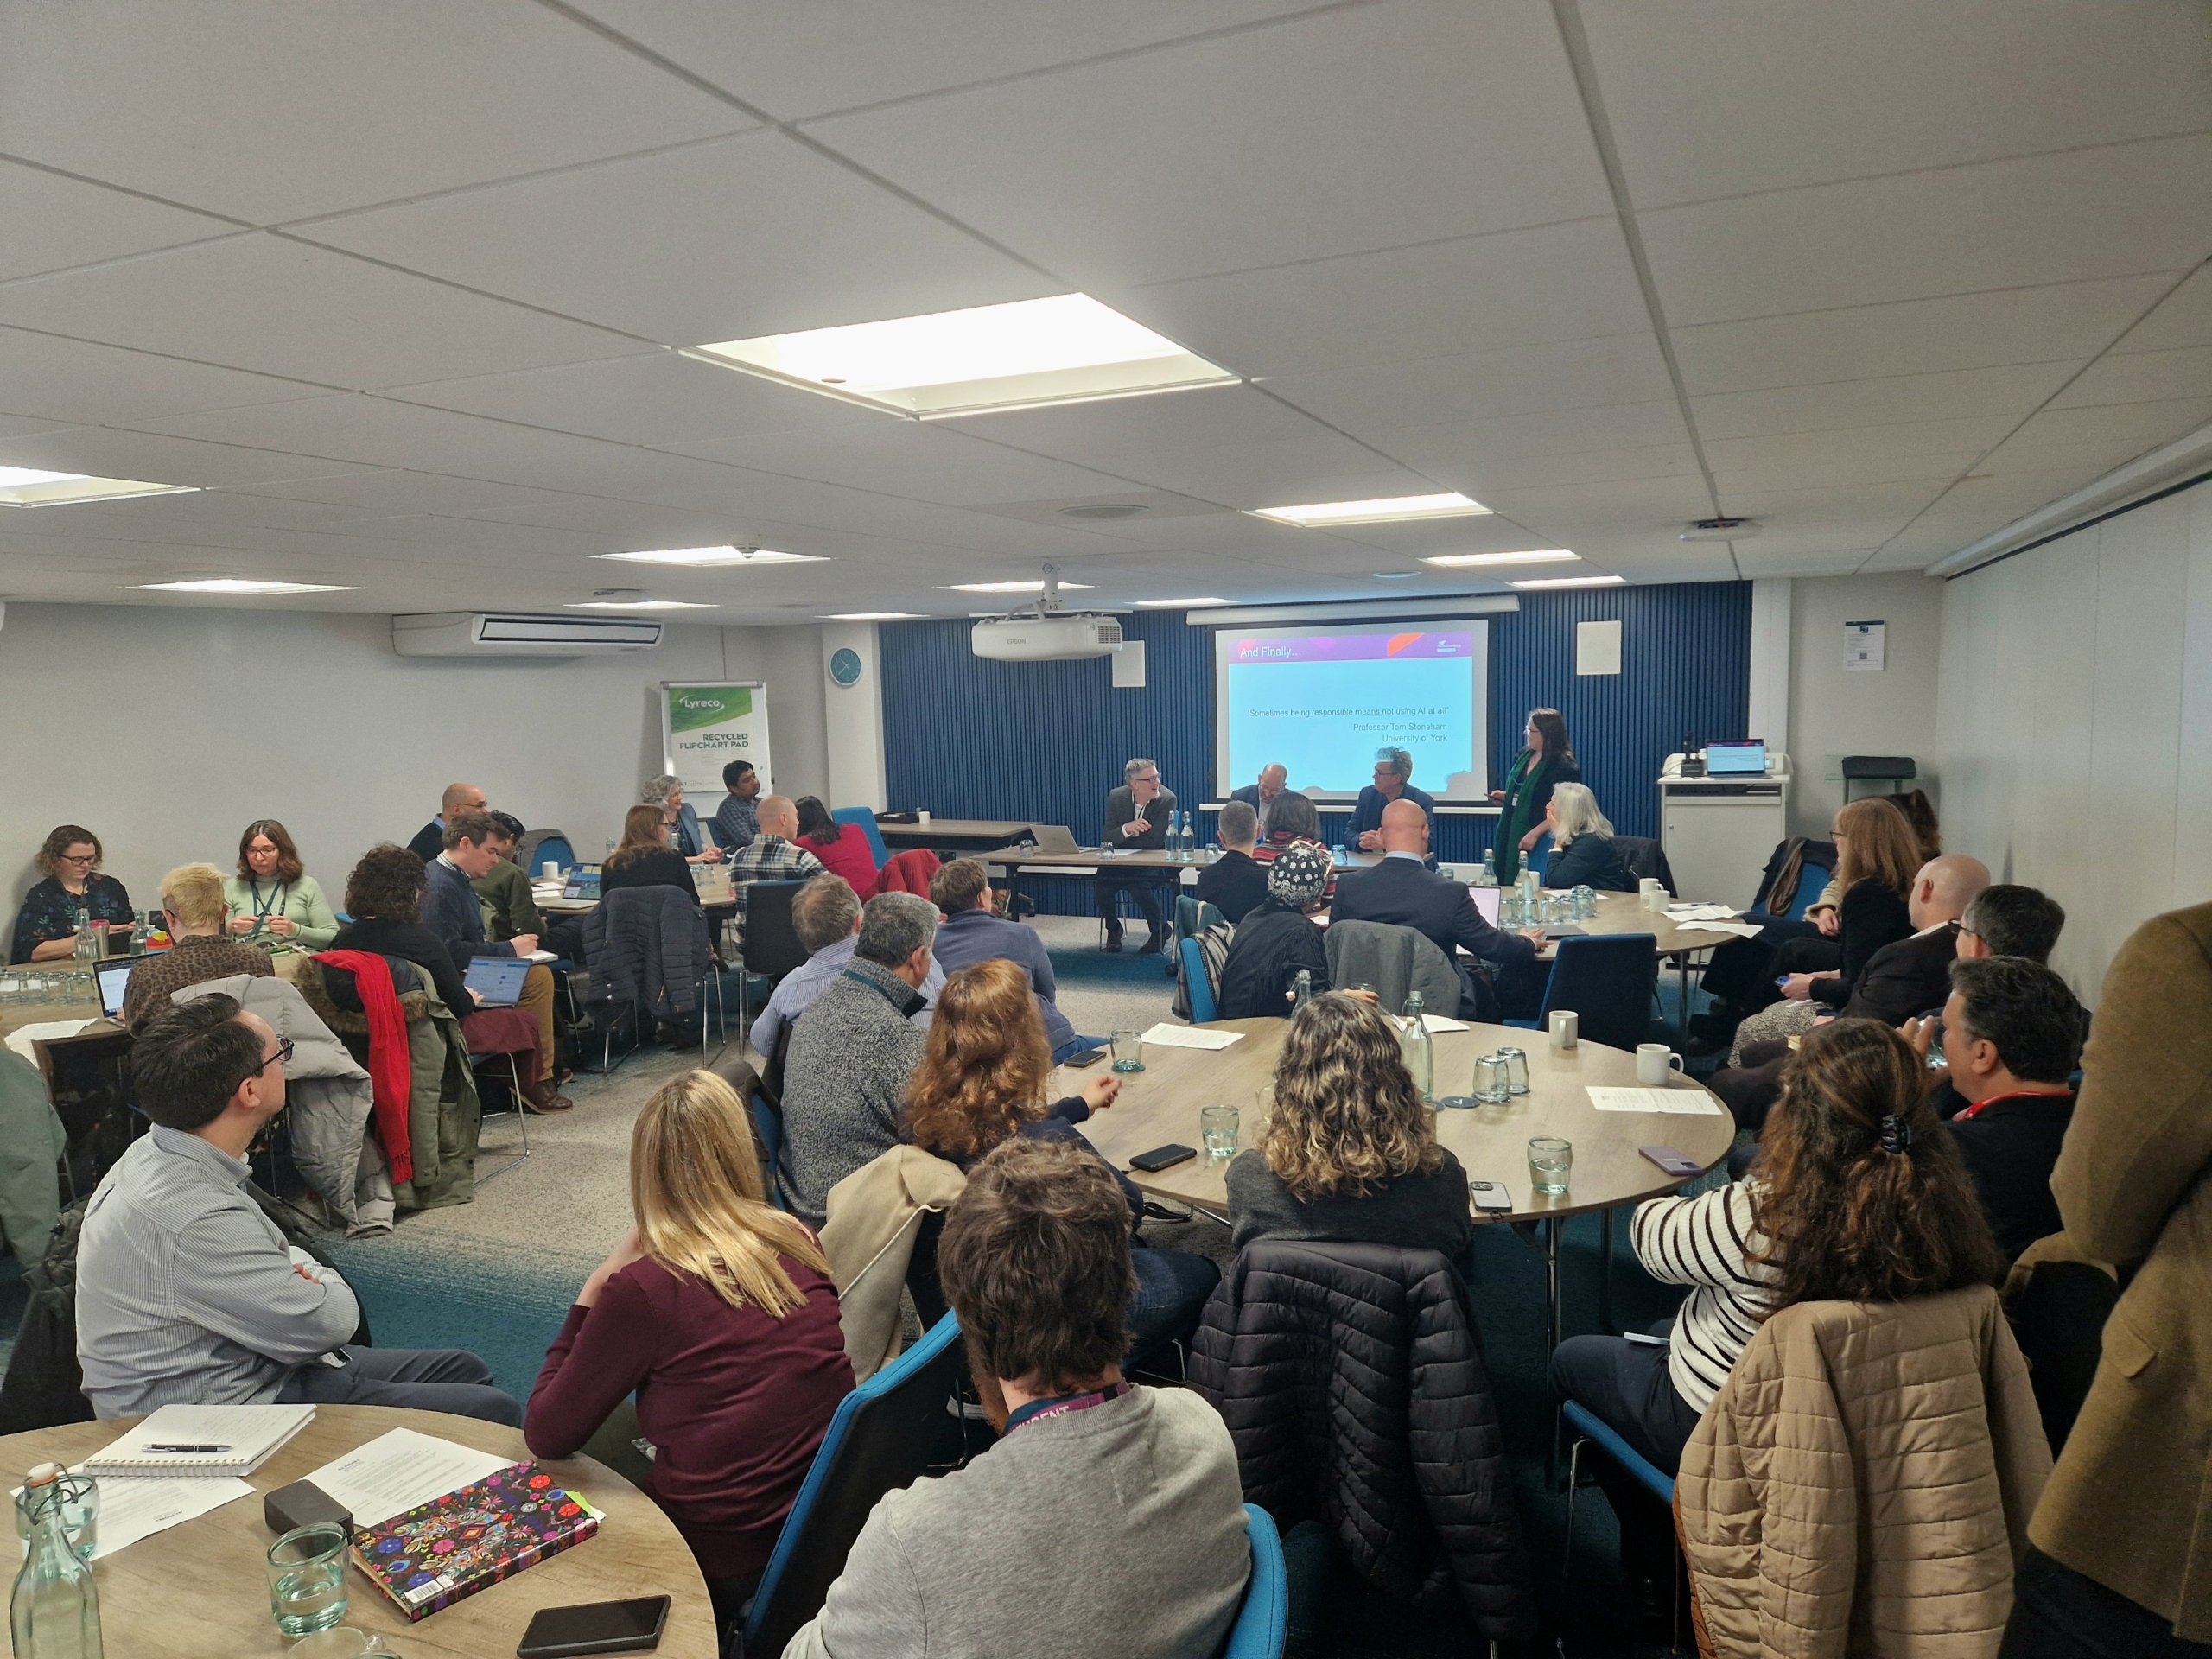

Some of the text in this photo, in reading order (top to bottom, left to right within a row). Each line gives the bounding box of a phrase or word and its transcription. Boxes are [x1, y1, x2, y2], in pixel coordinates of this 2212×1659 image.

[1240, 645, 1302, 659] And Finally...
[684, 699, 721, 709] Lyreco
[1290, 709, 1310, 718] being
[1312, 708, 1353, 718] responsible
[1395, 707, 1416, 716] using
[1390, 722, 1407, 731] Tom
[1408, 722, 1447, 731] Stoneham
[1382, 734, 1419, 744] University
[679, 741, 728, 750] FLIPCHART
